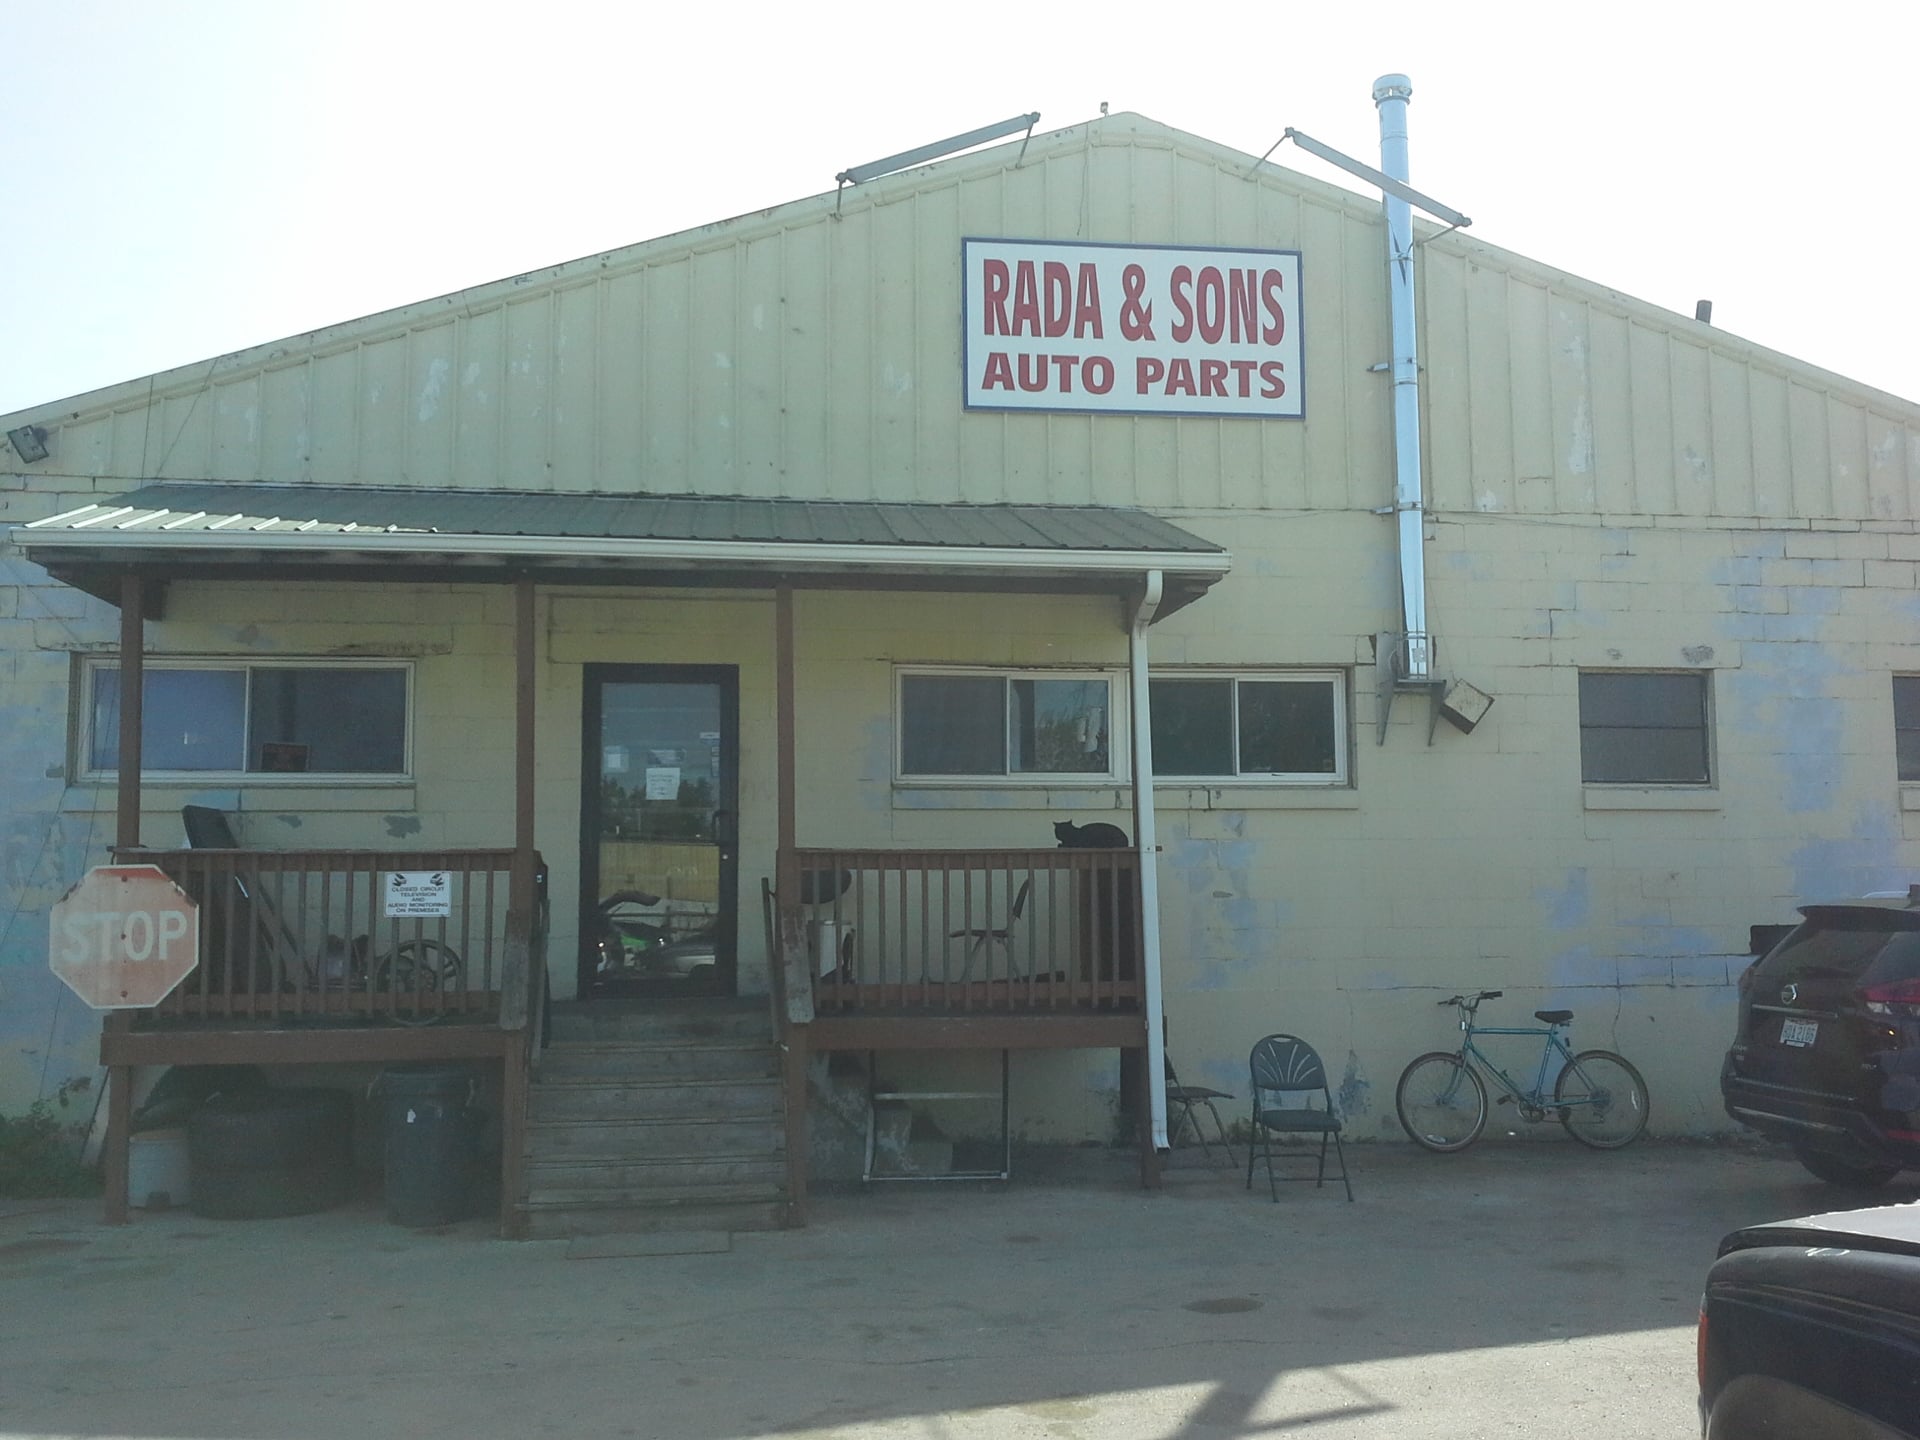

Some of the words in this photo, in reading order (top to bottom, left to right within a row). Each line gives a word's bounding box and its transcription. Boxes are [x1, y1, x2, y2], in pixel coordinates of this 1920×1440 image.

[983, 258, 1104, 339] RADA
[1119, 263, 1156, 342] &
[1170, 265, 1285, 346] SONS
[981, 352, 1115, 395] AUTO
[1136, 357, 1286, 399] PARTS
[61, 911, 187, 962] STOP
